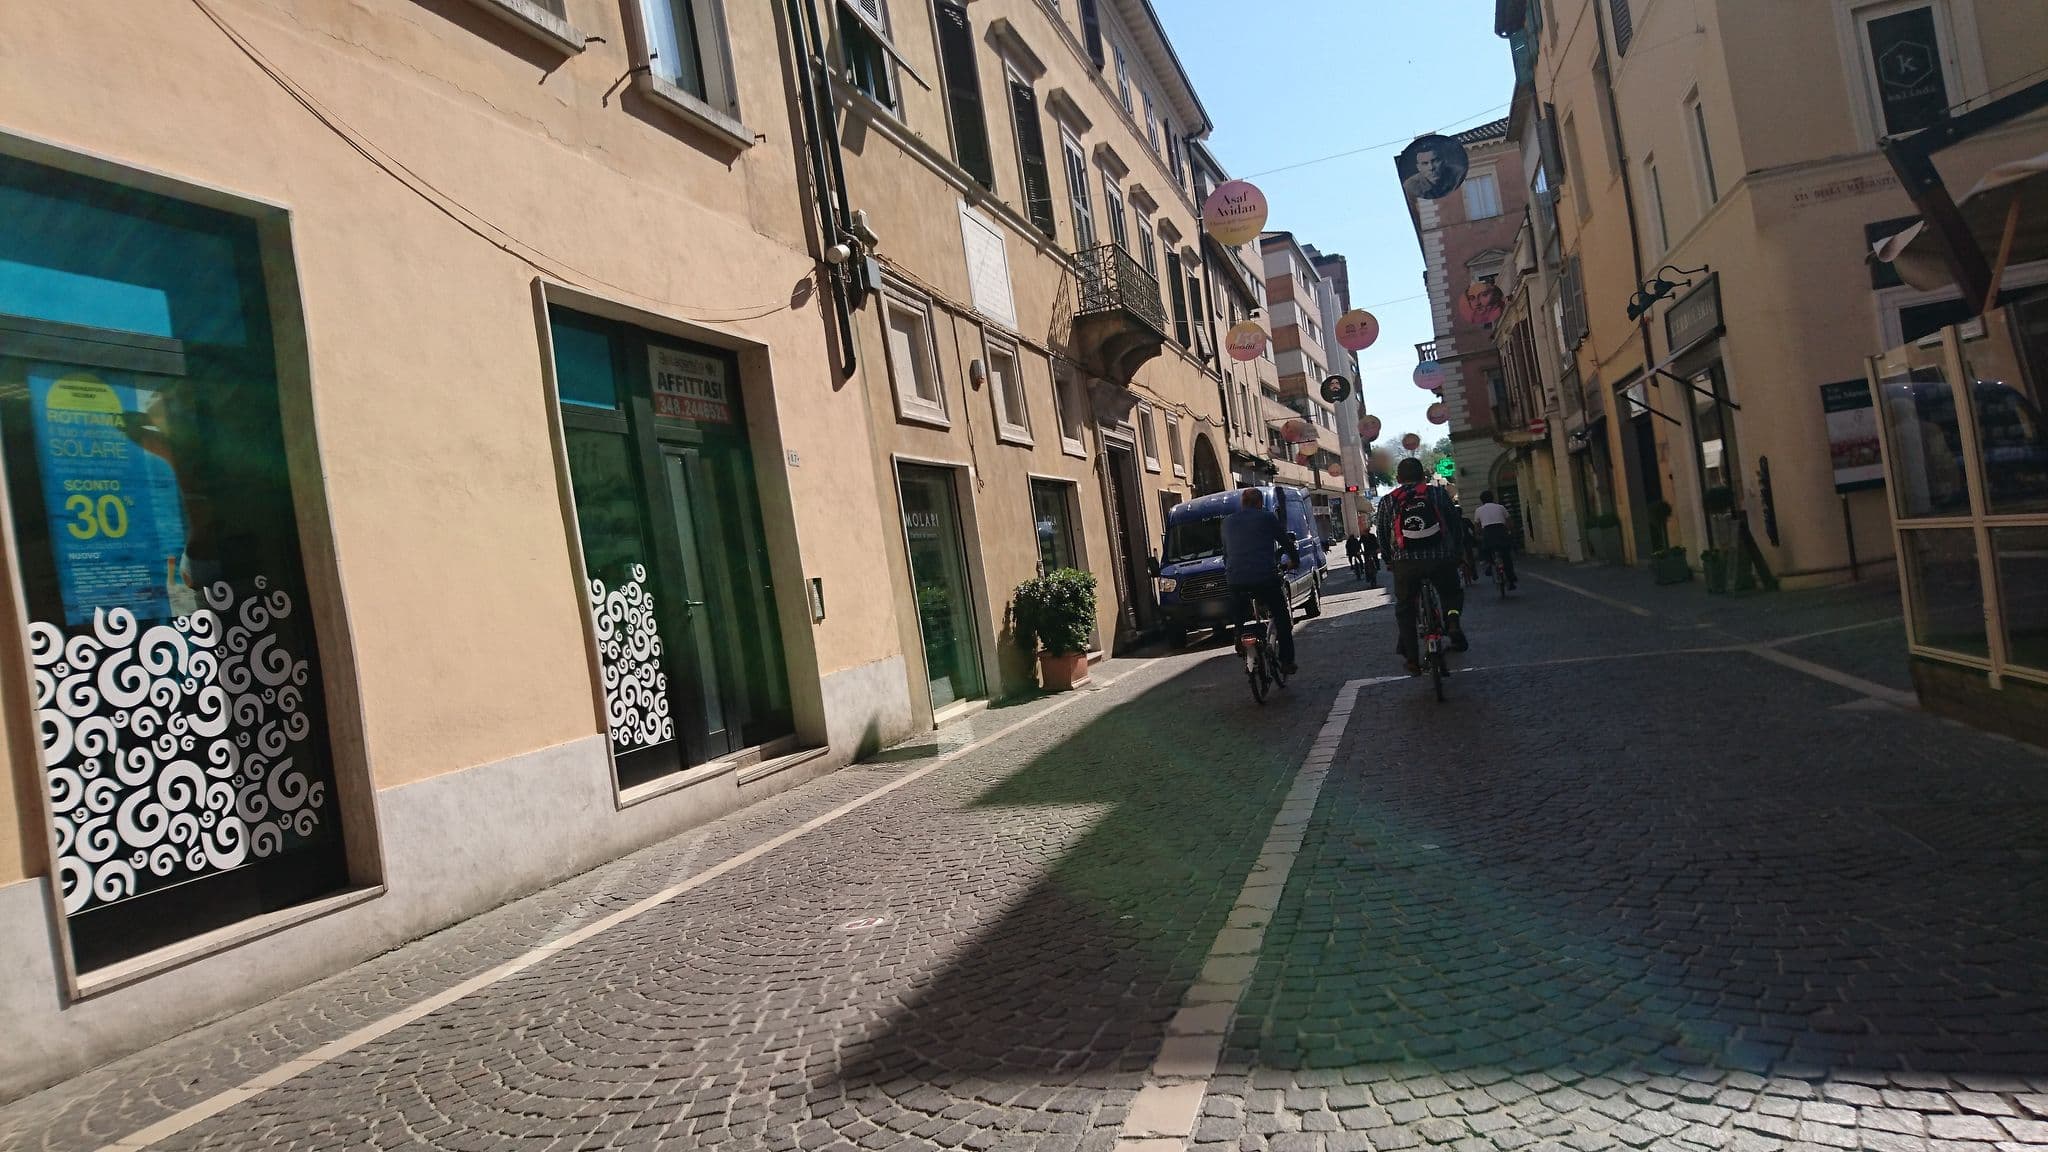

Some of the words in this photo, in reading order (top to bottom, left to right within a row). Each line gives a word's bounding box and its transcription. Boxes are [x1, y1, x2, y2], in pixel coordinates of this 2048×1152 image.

[1224, 191, 1249, 205] Asaf
[1217, 204, 1256, 217] Avidan
[658, 371, 722, 400] AFFITTASI
[49, 438, 129, 459] SOLARE
[63, 479, 120, 491] SCONTO
[905, 512, 939, 528] MOLARI
